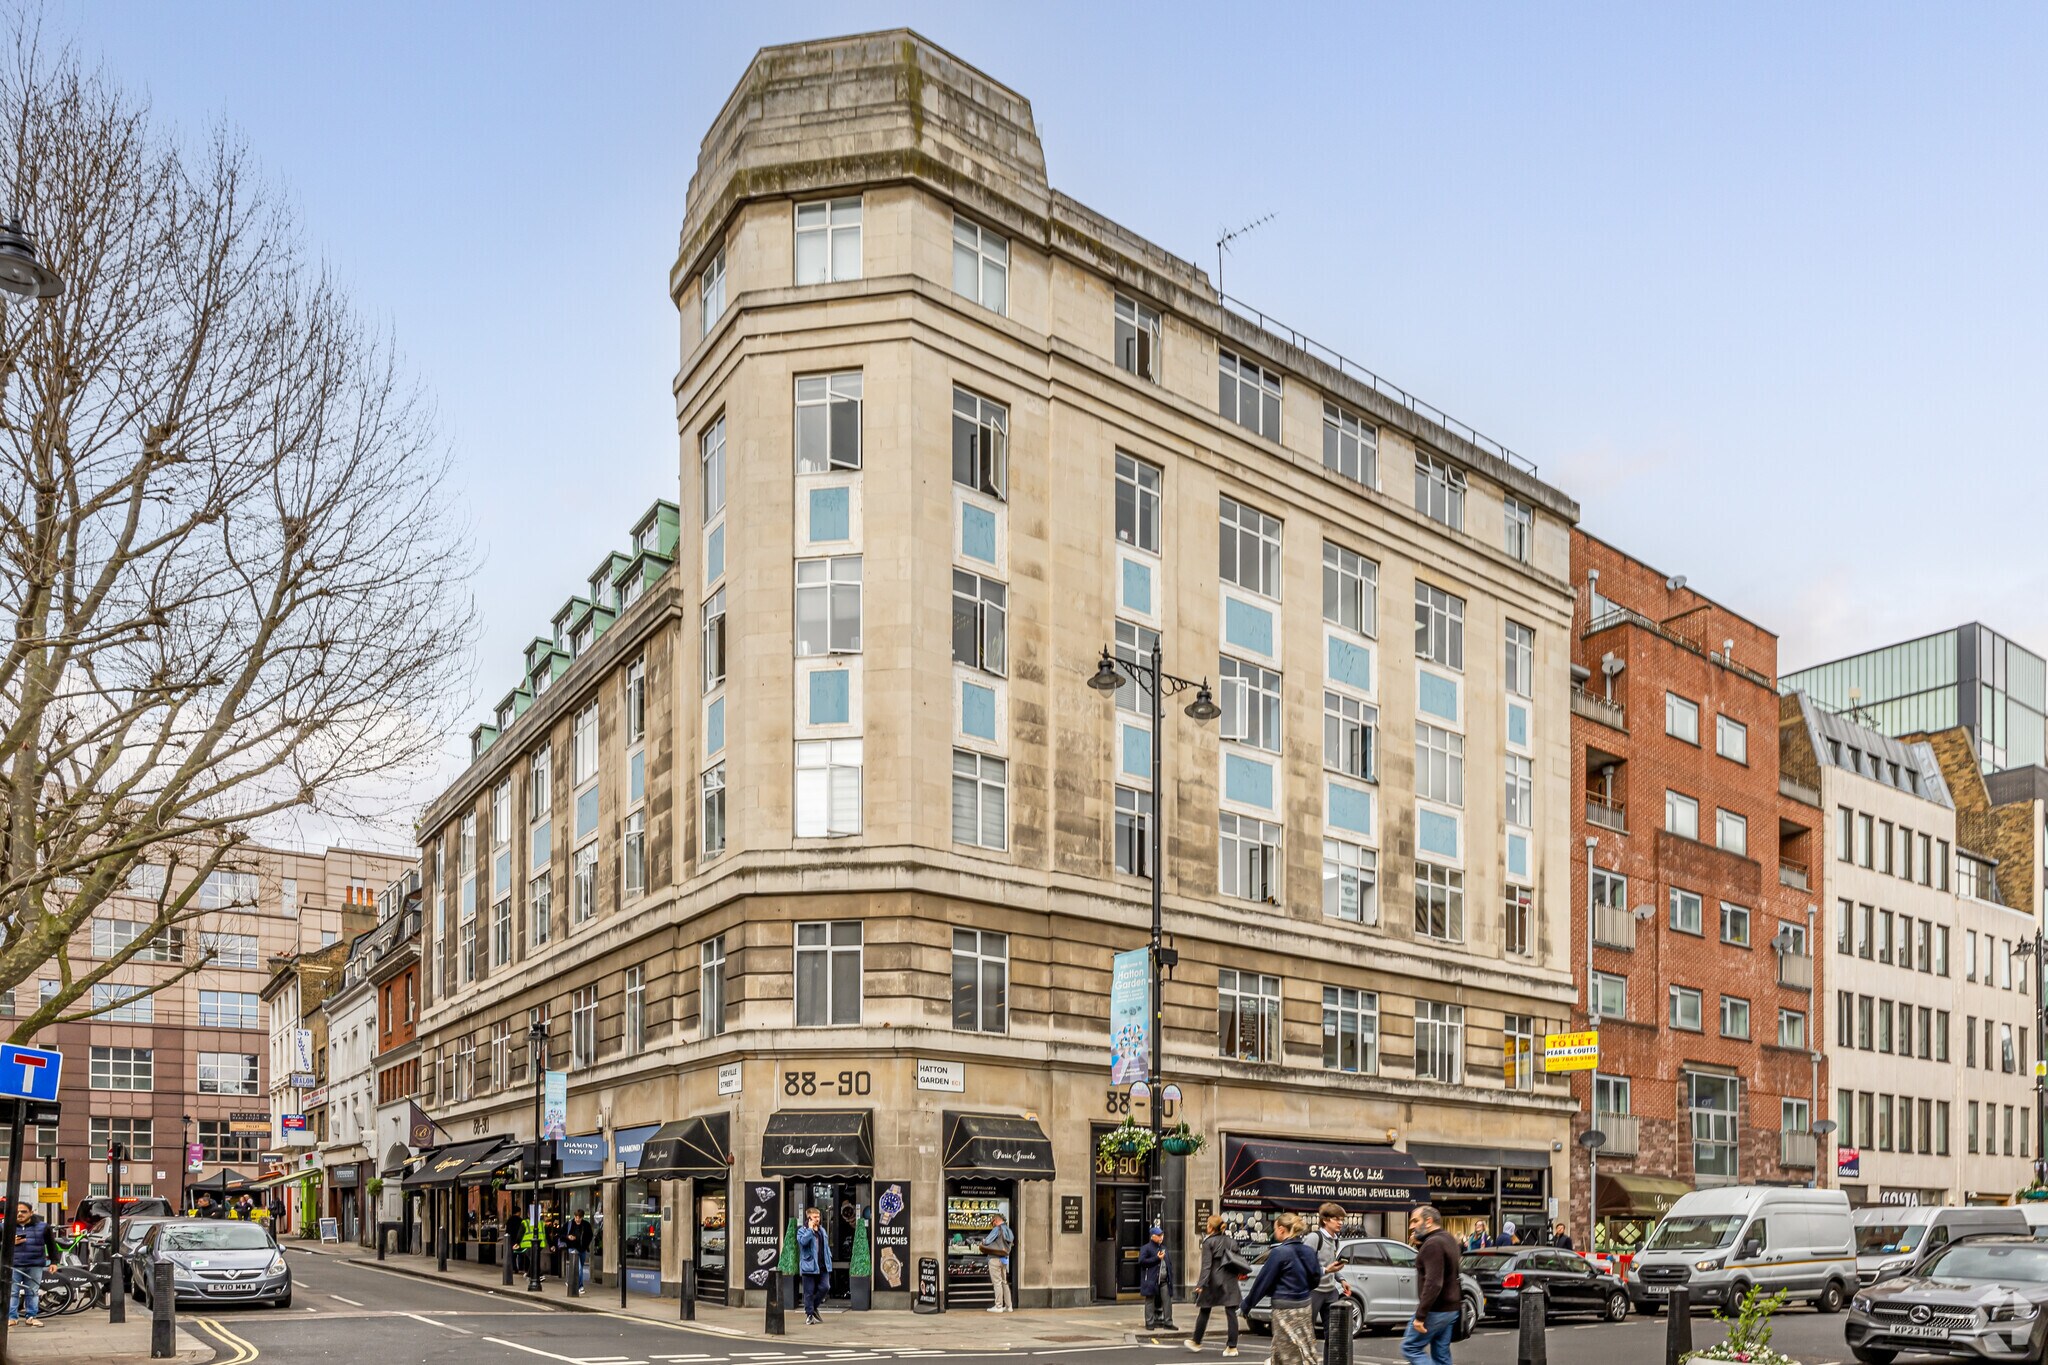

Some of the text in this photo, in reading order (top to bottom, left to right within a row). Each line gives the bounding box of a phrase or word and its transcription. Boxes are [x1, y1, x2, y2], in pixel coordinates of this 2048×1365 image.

[1117, 969, 1144, 980] Hatton
[1114, 978, 1146, 990] Garden
[1551, 1038, 1593, 1048] TO LET
[1546, 1048, 1566, 1056] PEARL
[1574, 1046, 1597, 1054] COUTTS
[720, 1068, 737, 1078] GREVILLE
[920, 1064, 948, 1074] HATTON
[720, 1080, 734, 1089] STREET
[784, 1070, 871, 1096] 88-90
[920, 1076, 950, 1086] GARDEN
[619, 1144, 641, 1154] DIAMOND
[782, 1143, 835, 1158] Paris Jewels
[992, 1148, 1036, 1163] Paris Jewels
[1309, 1165, 1384, 1182] E Katz & Co Ltd
[1445, 1171, 1486, 1189] Jewels
[1290, 1183, 1410, 1199] THE HATTON GARDEN JEWELLERS
[750, 1226, 774, 1235] WE BUY
[880, 1226, 905, 1235] WE BUY
[746, 1236, 778, 1245] JEWELLERY
[876, 1236, 908, 1245] WATCHES
[1894, 1327, 1944, 1338] KP23 HSK
